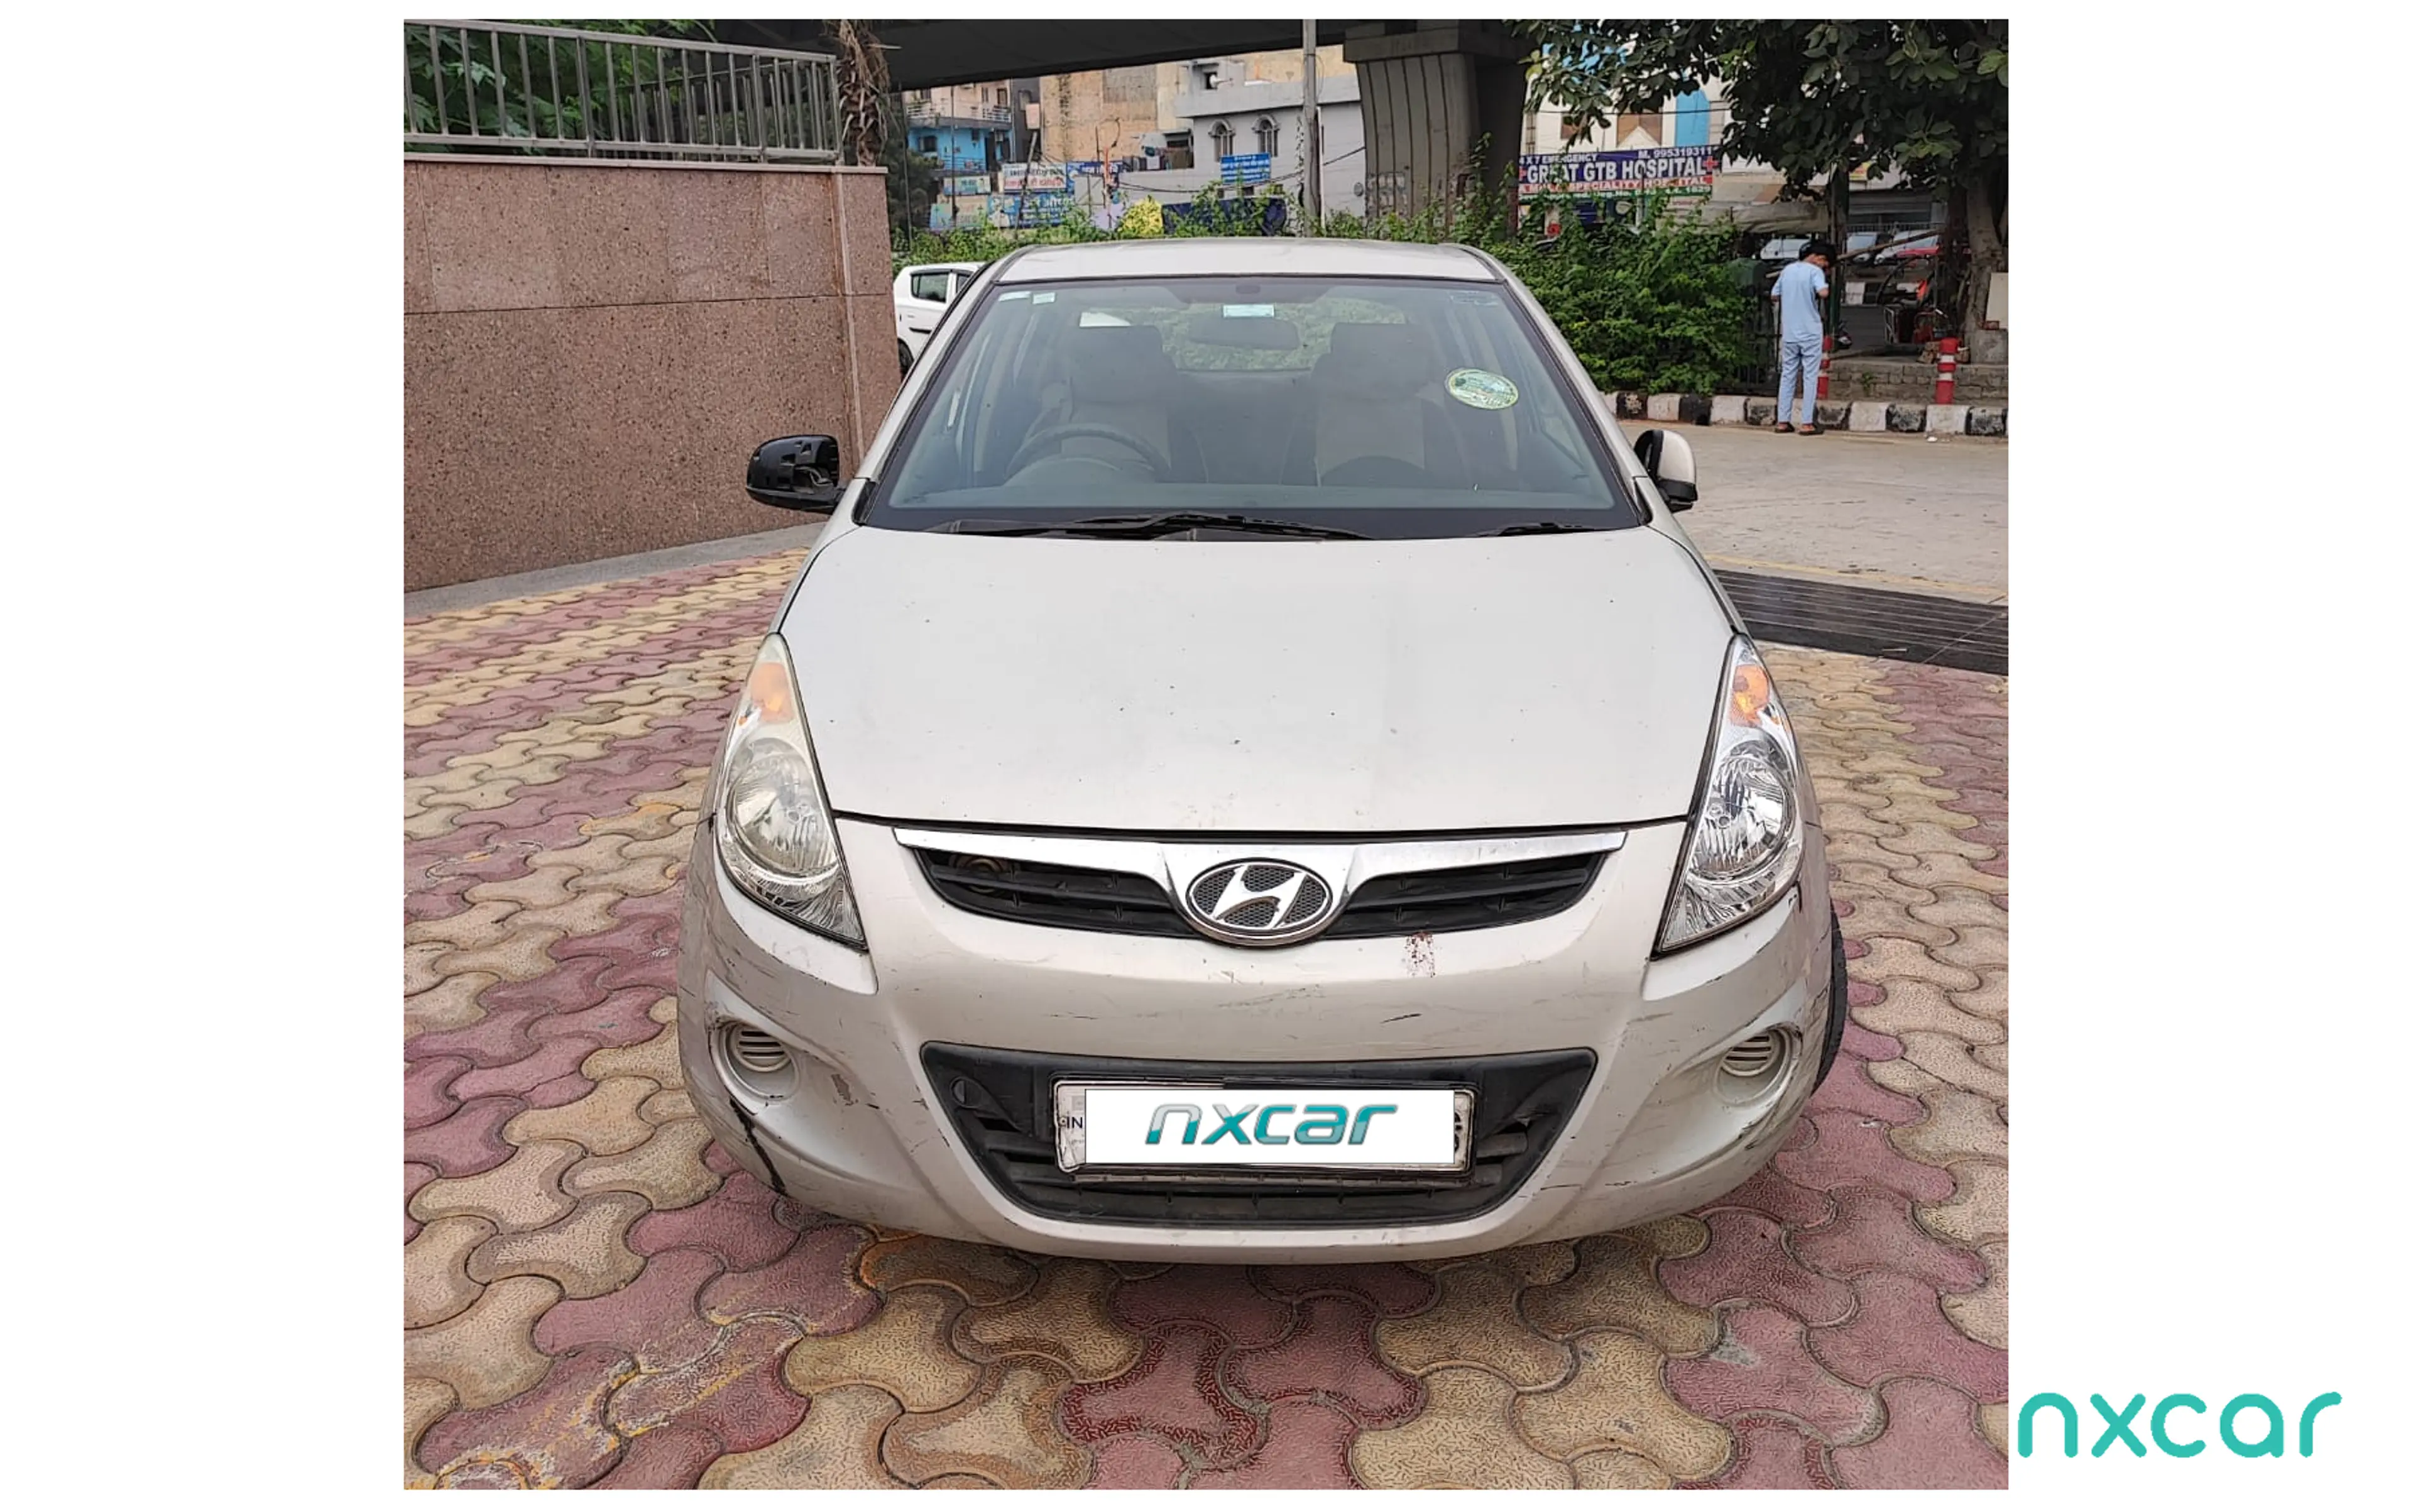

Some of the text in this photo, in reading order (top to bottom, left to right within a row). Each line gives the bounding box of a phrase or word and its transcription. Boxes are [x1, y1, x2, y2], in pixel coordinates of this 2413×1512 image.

[1584, 162, 1617, 181] GTB
[1622, 156, 1706, 179] HOSPITAL
[1644, 176, 1704, 188] HOSITAL
